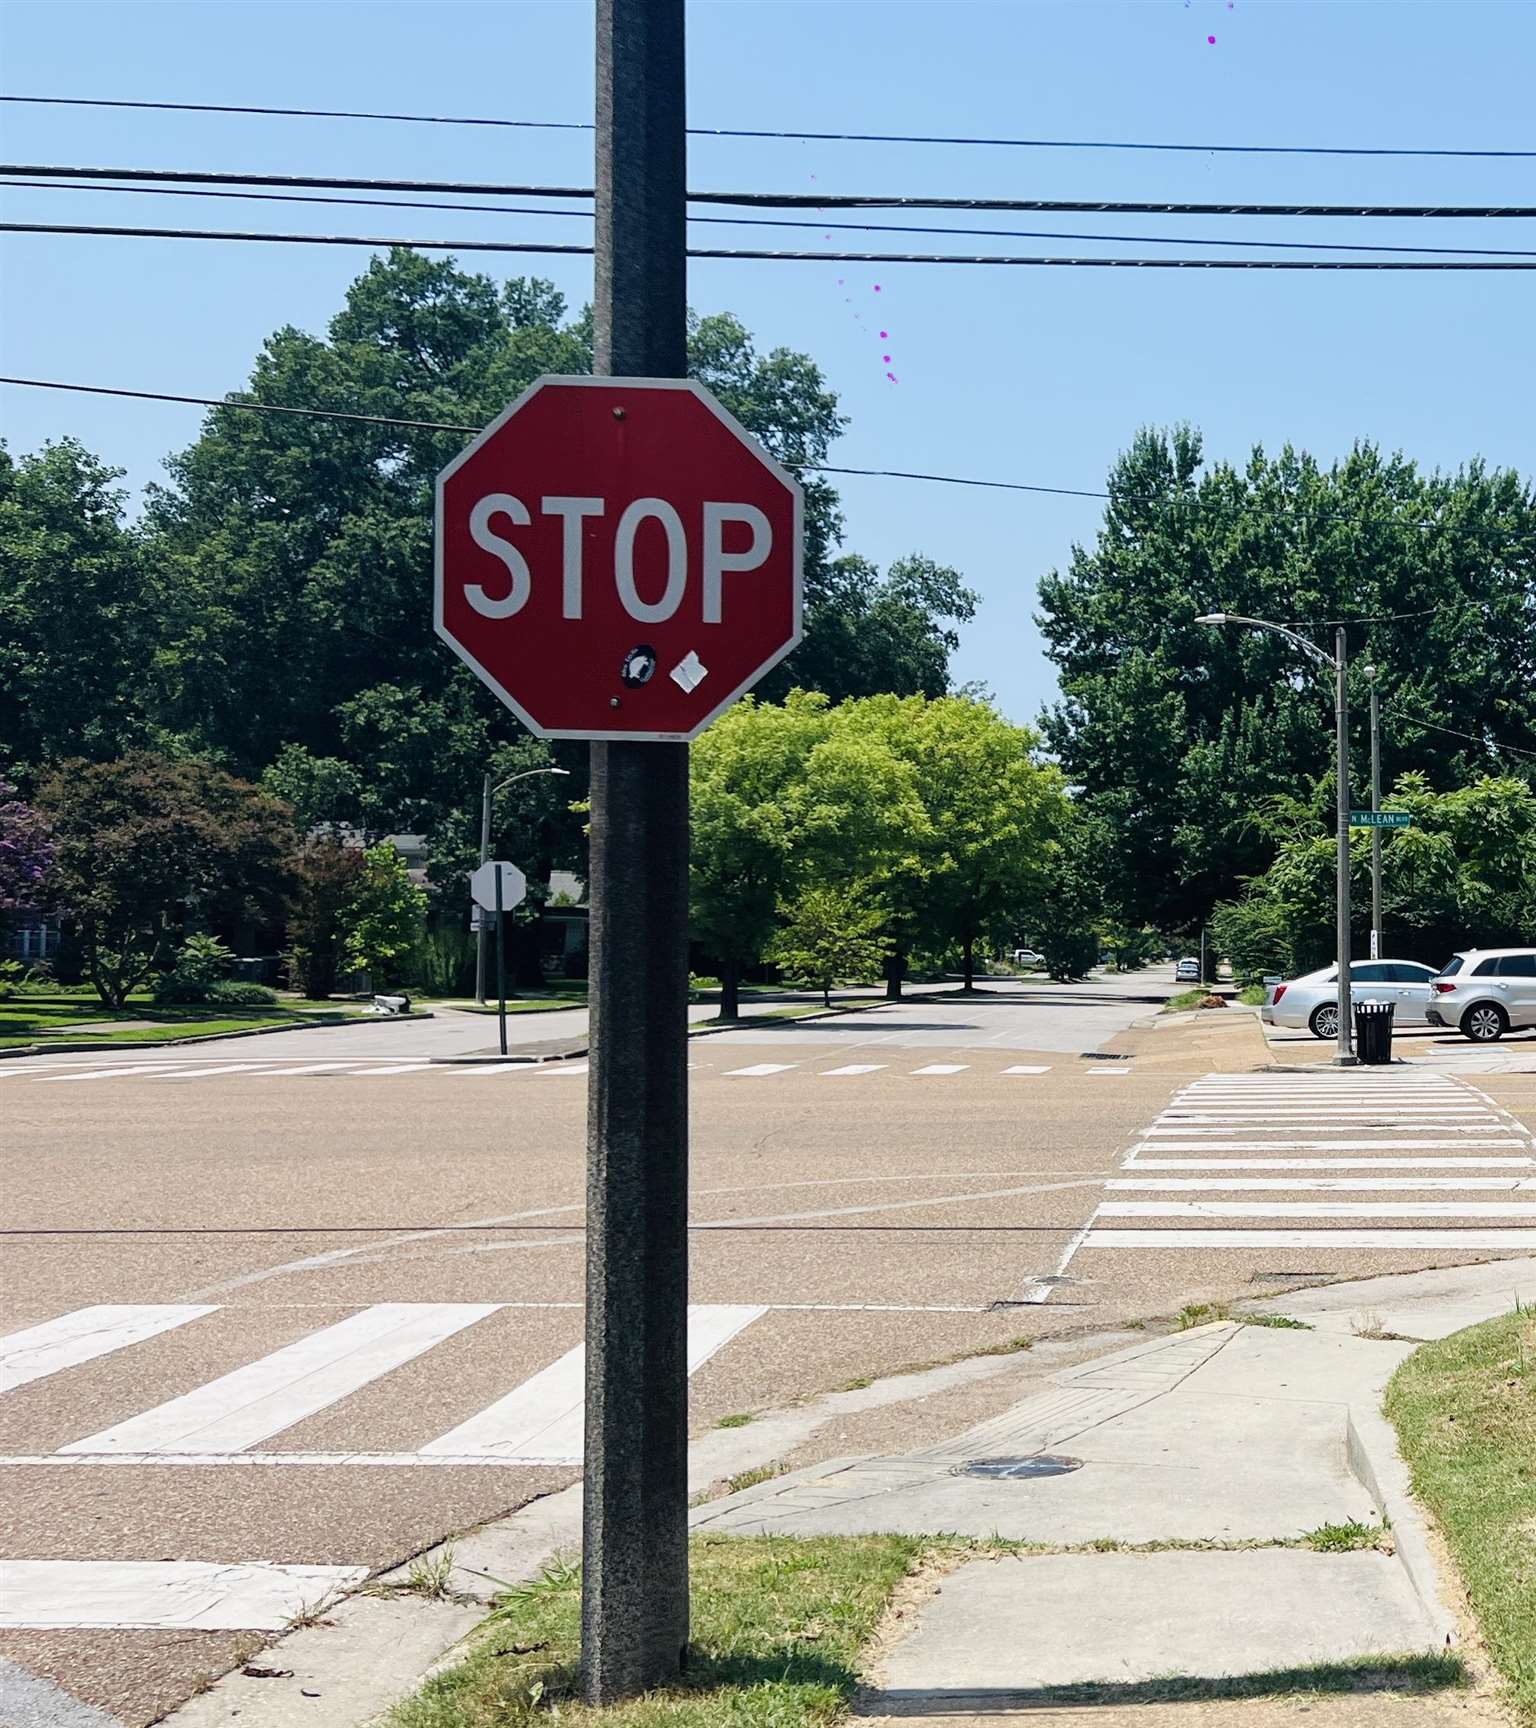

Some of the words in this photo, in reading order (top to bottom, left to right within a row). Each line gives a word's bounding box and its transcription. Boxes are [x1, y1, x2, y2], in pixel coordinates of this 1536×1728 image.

[463, 492, 773, 625] STOP
[1351, 815, 1357, 823] N
[1361, 814, 1394, 824] McLEAN
